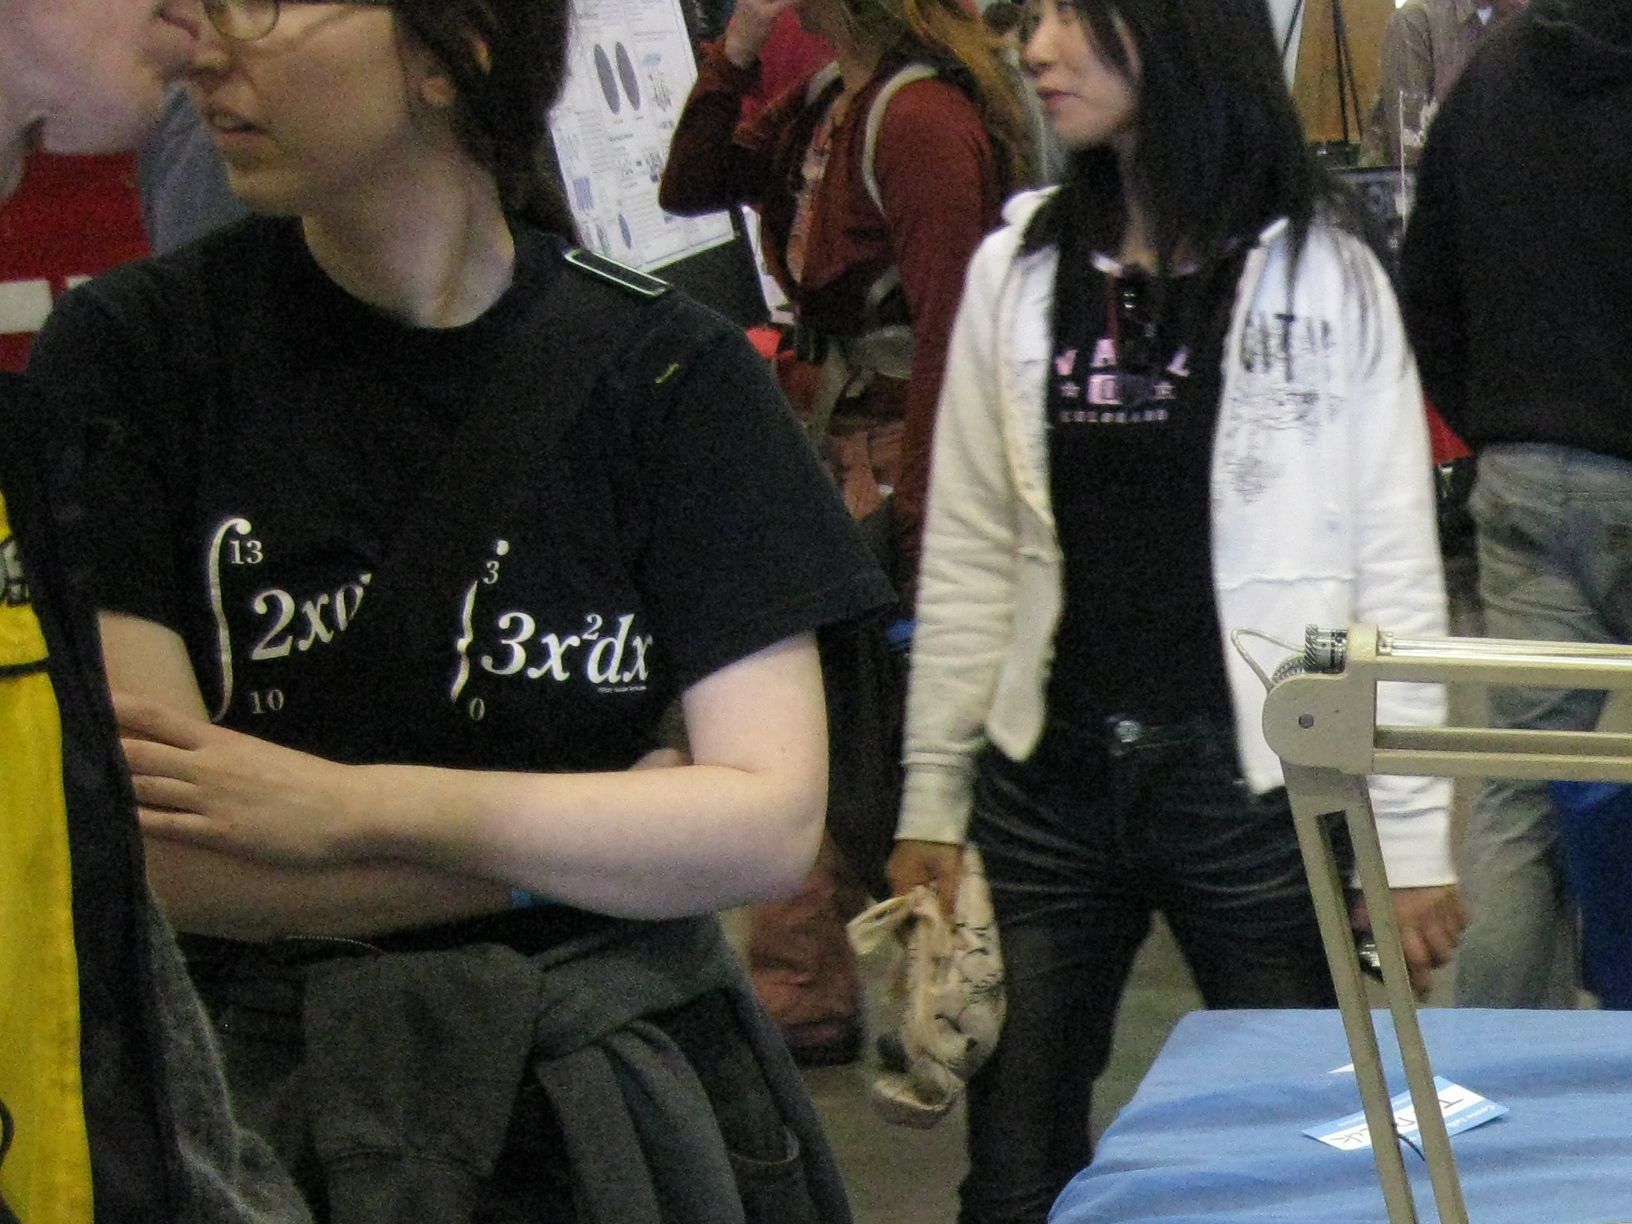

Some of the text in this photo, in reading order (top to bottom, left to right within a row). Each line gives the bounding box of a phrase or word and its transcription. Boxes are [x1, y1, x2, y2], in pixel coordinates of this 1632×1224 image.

[231, 539, 264, 565] 13
[483, 560, 500, 586] 3
[250, 687, 285, 716] 10
[469, 696, 486, 723] 0
